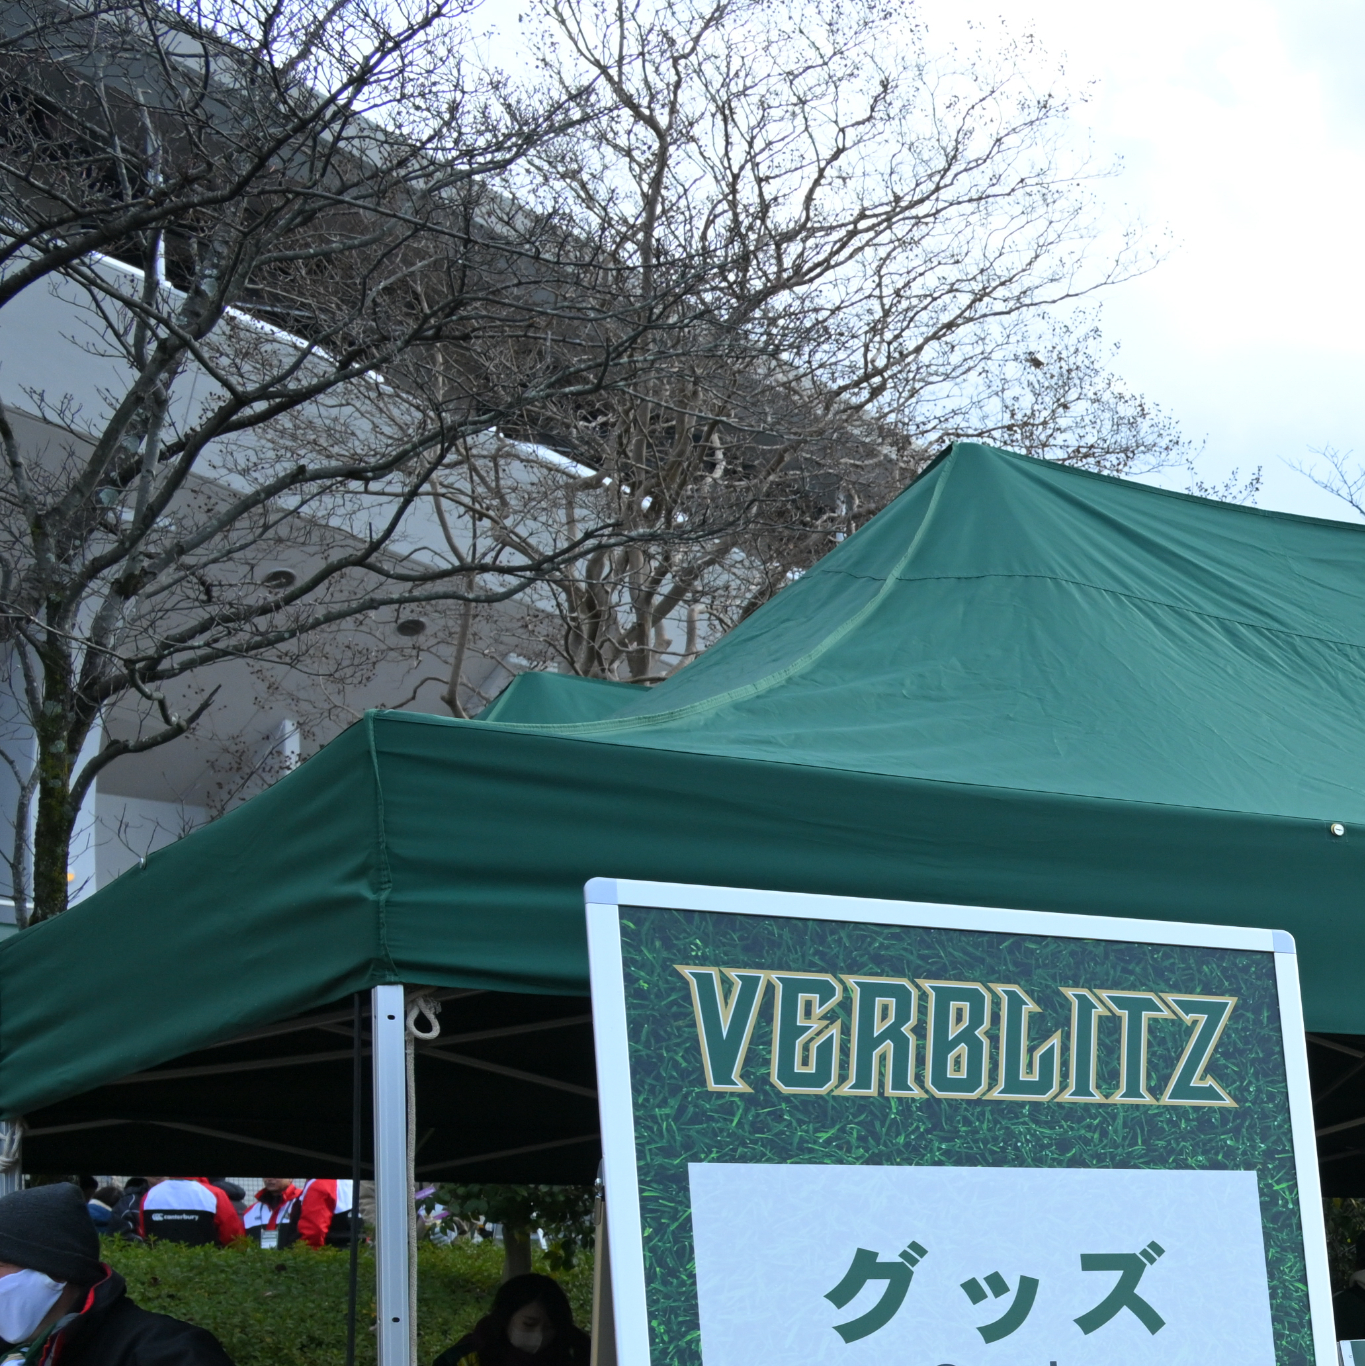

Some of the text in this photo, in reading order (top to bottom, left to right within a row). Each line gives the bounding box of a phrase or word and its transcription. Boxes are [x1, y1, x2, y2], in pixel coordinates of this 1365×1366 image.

[674, 964, 1239, 1108] VERBLITZ
[163, 1213, 199, 1221] canterbury
[822, 1240, 1167, 1344] グッズ
